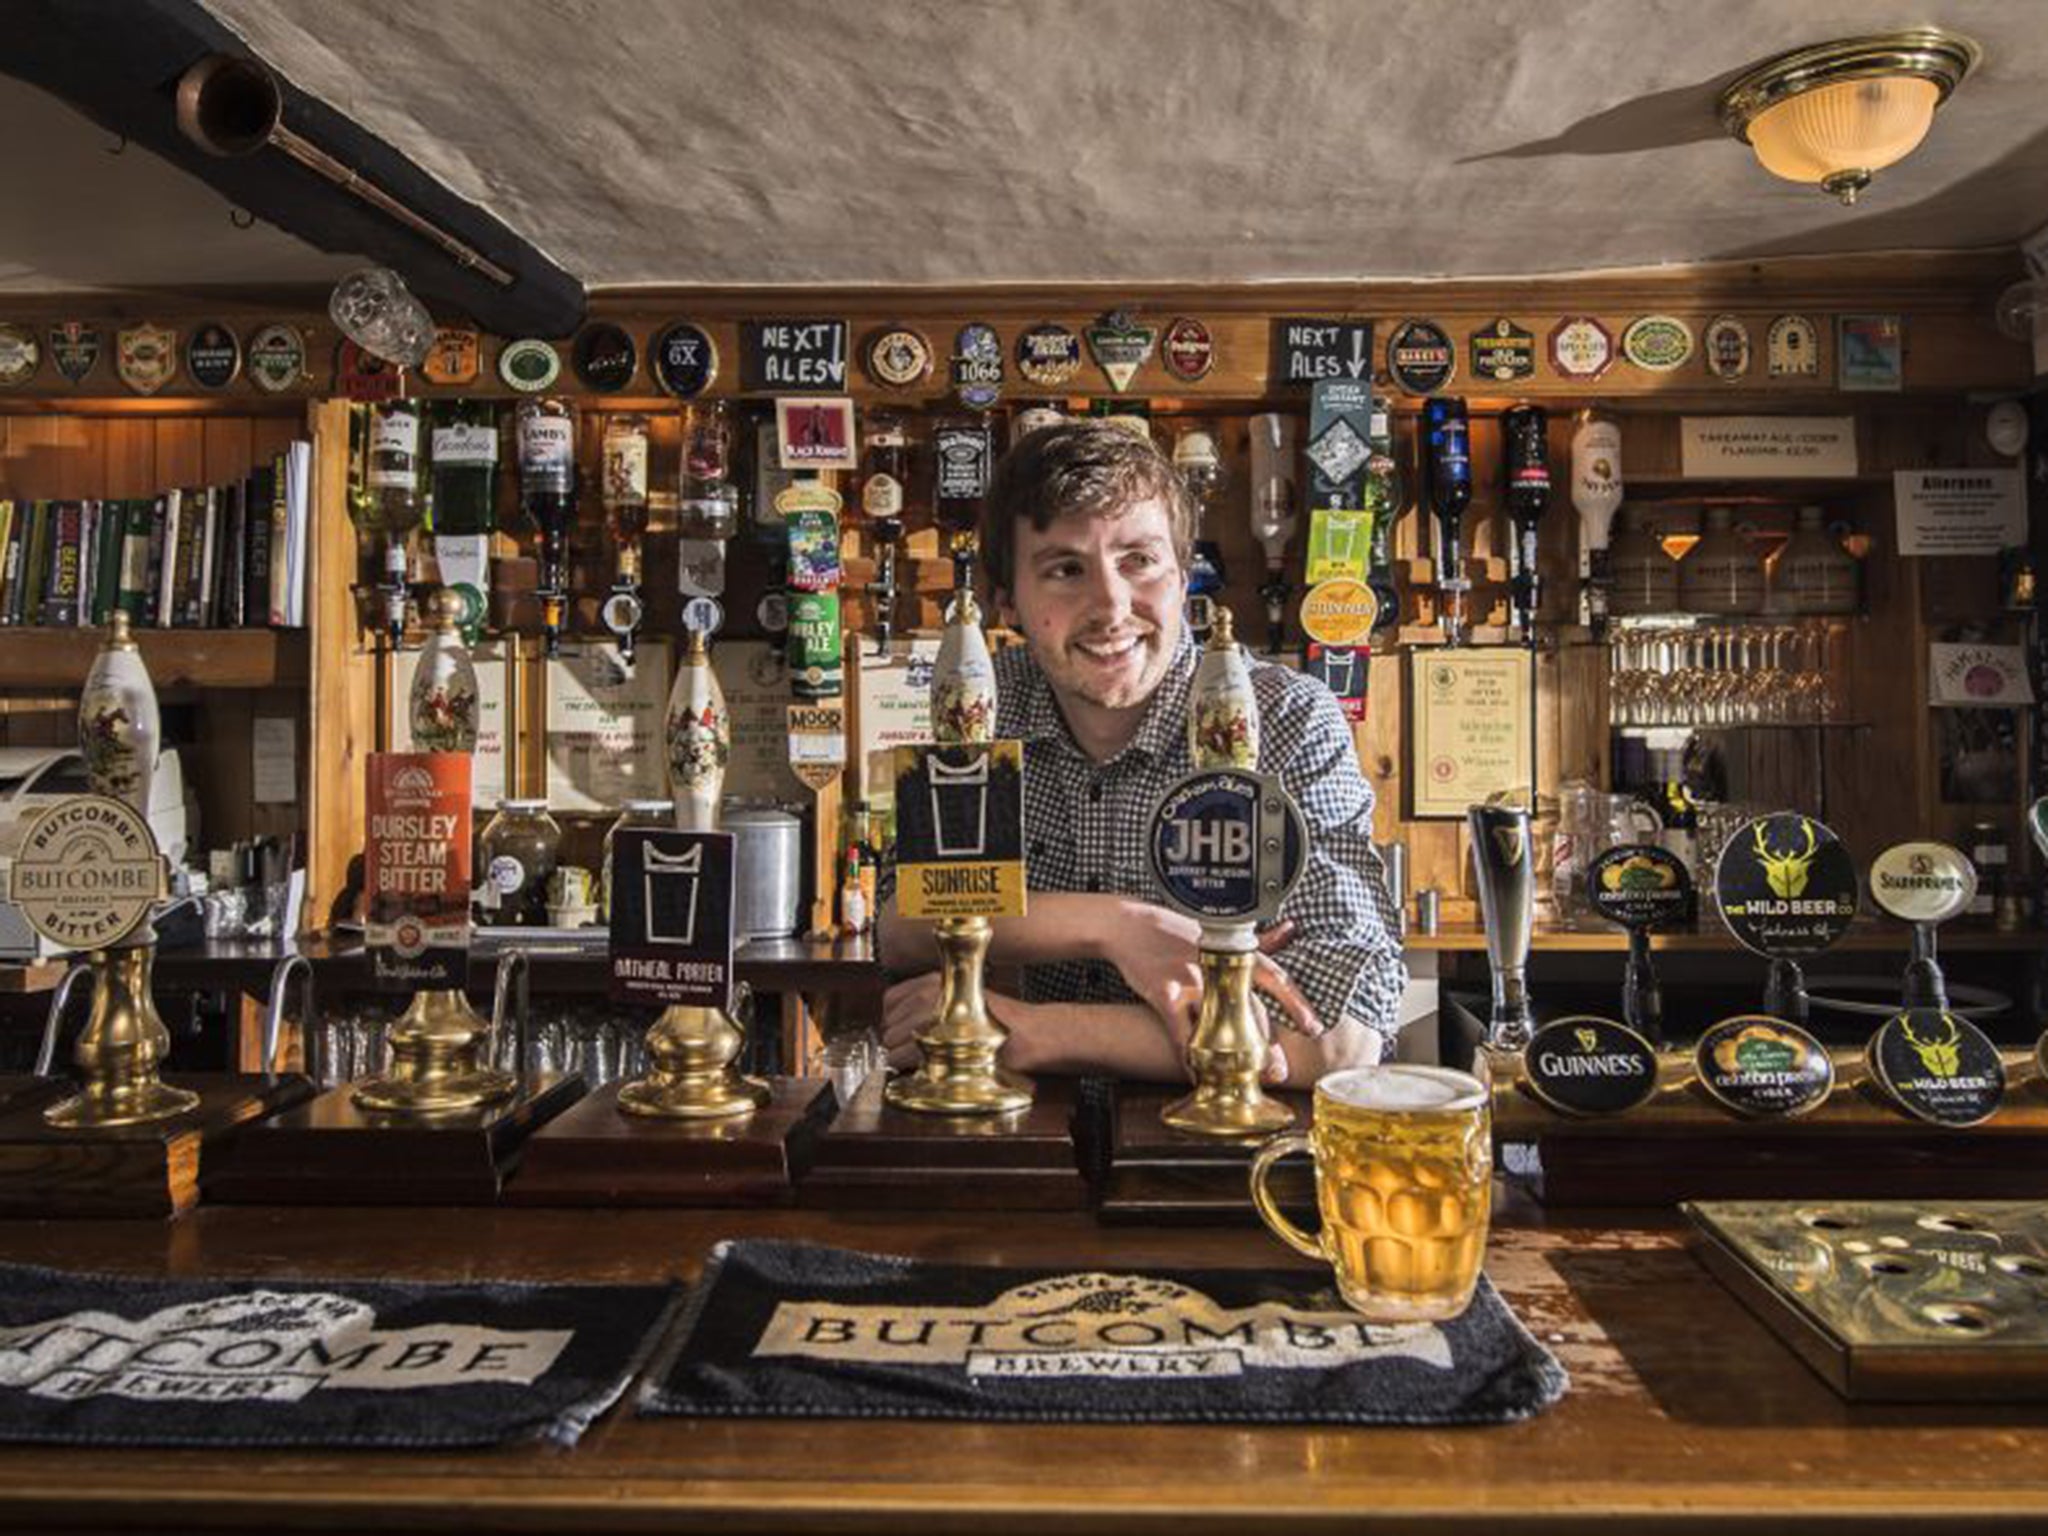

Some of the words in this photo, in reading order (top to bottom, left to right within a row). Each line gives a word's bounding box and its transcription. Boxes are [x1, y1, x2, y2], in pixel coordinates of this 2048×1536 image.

[762, 325, 830, 351] NEXT
[1288, 326, 1340, 347] NEXT
[667, 343, 699, 367] 6X
[1290, 351, 1342, 379] ALES
[765, 356, 828, 383] ALES
[959, 364, 1001, 382] 1066
[33, 805, 139, 849] BUTCOMBE
[372, 814, 459, 840] DURSLEY
[379, 841, 447, 865] STEAM
[1164, 819, 1252, 863] JHB
[21, 868, 150, 890] BUTCOMBE
[379, 867, 447, 892] BITTER
[921, 866, 1003, 896] SUNRISE
[1746, 899, 1789, 915] WILD
[1790, 899, 1837, 915] BEER
[1837, 905, 1854, 915] CO
[44, 910, 122, 938] BITTER
[614, 957, 674, 980] OATMEAL
[676, 962, 725, 983] PORTER
[1539, 1052, 1646, 1077] GUINNESS
[803, 1316, 1407, 1349] BUTCOMBE
[993, 1354, 1215, 1373] BREWERY
